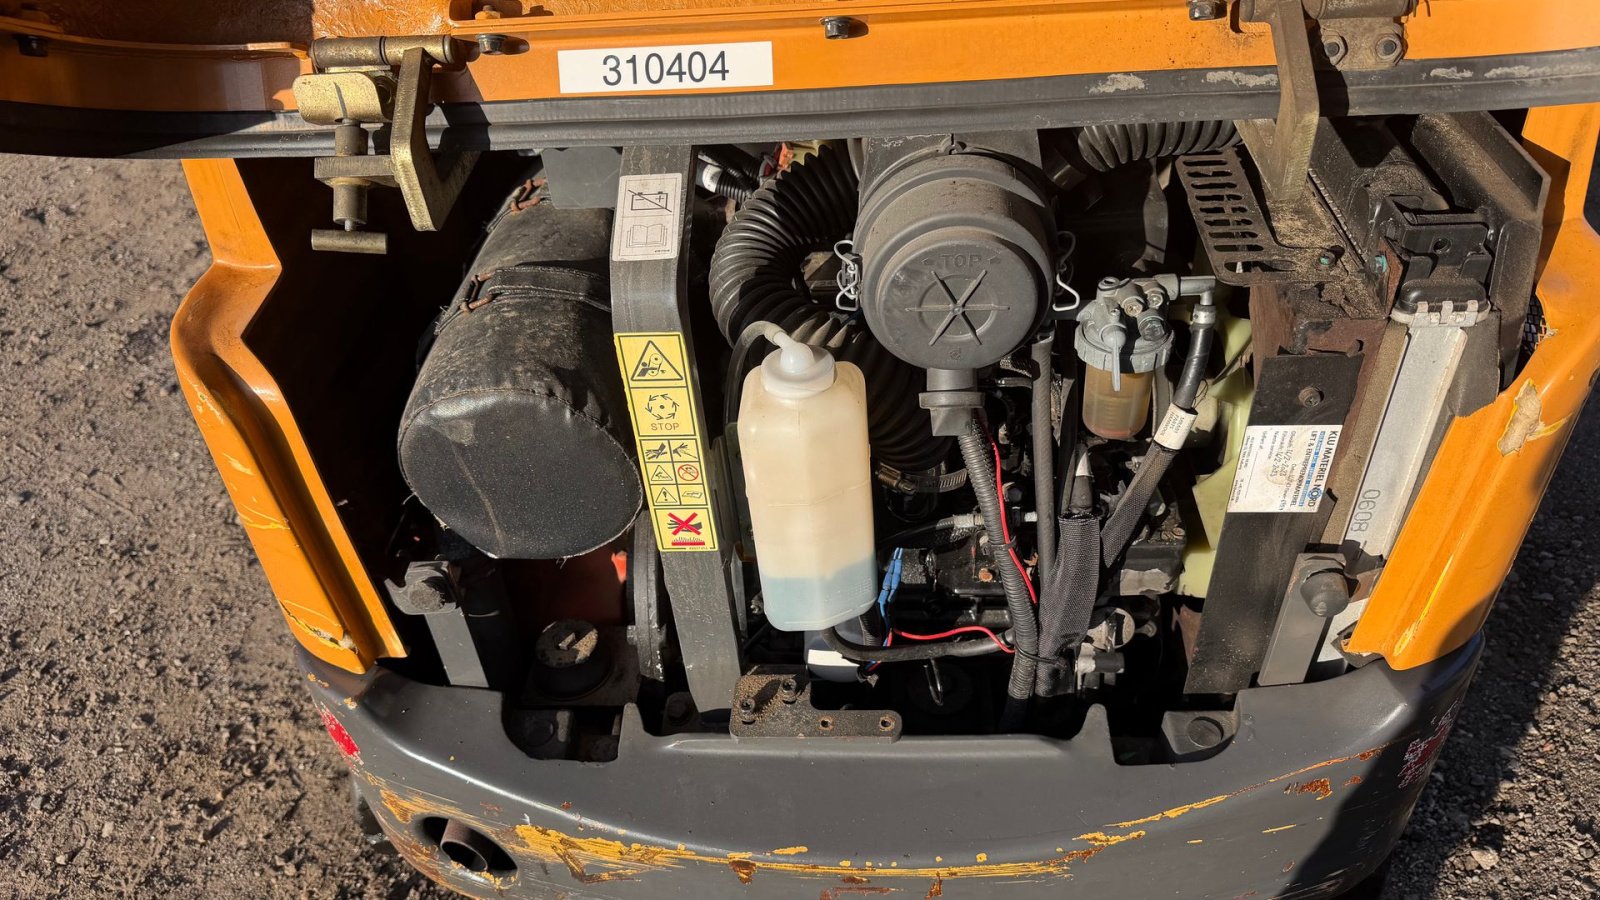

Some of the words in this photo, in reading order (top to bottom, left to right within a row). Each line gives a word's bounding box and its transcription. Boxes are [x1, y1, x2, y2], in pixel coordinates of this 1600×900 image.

[602, 50, 730, 86] 310404
[940, 253, 982, 269] TOP
[650, 422, 680, 431] STOP
[1310, 430, 1318, 441] LIFT
[1326, 430, 1339, 446] KLU
[1314, 447, 1333, 483] MATERIEL
[1307, 484, 1323, 507] NORD
[1350, 489, 1381, 532] 0608
